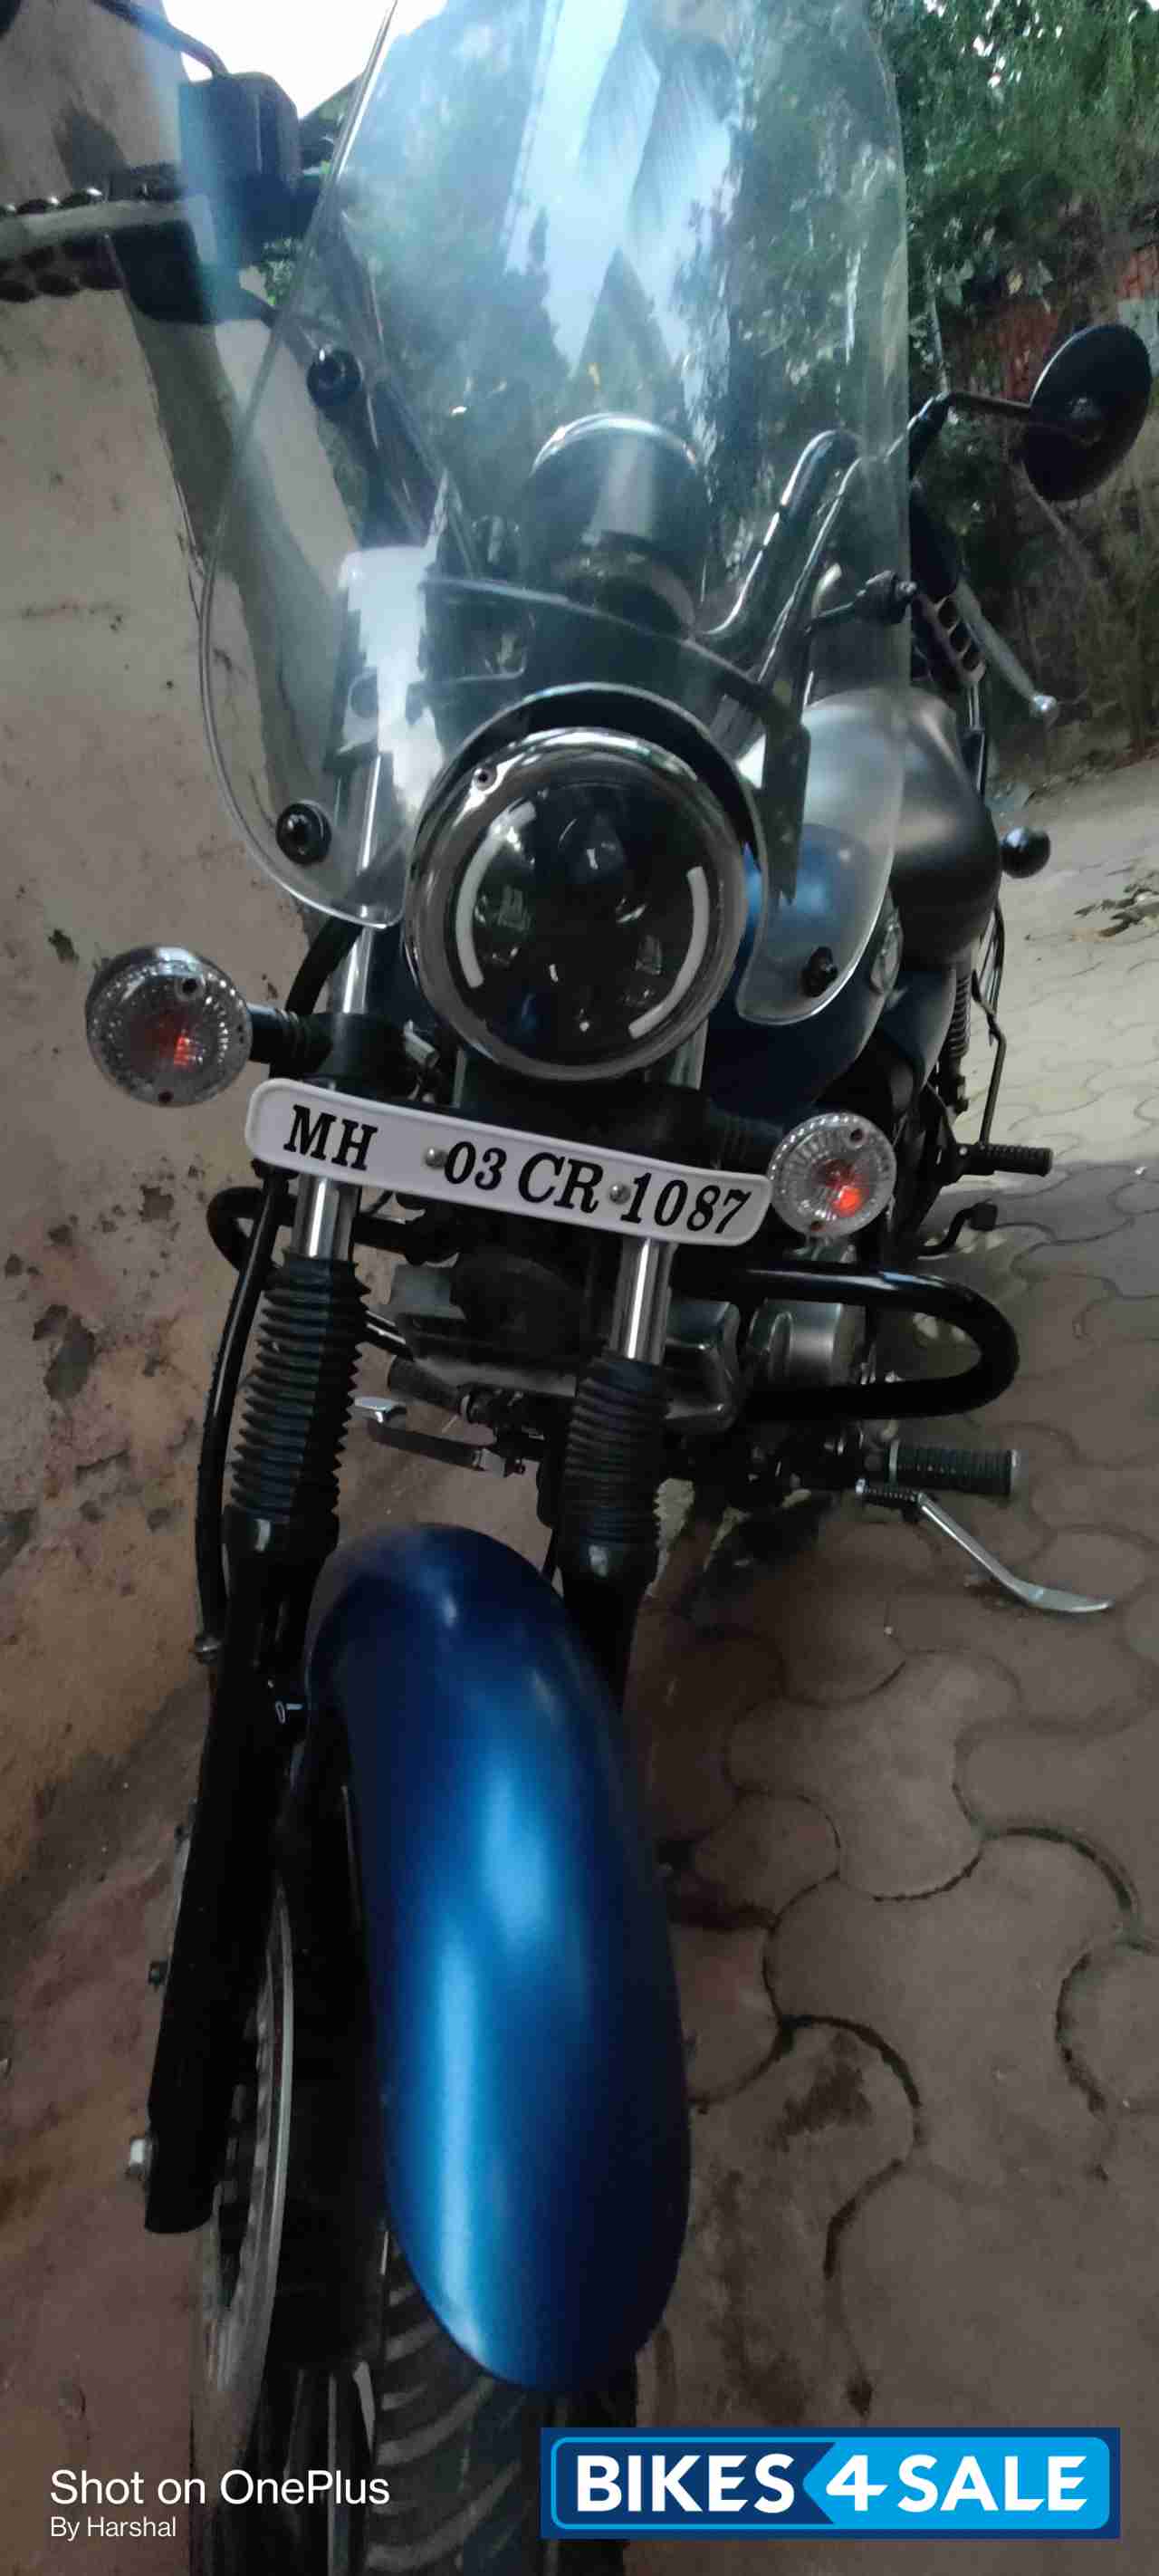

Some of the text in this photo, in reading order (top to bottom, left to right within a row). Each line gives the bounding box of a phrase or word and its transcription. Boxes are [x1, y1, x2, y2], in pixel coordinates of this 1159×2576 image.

[283, 1104, 752, 1235] MH 03 CR 1087
